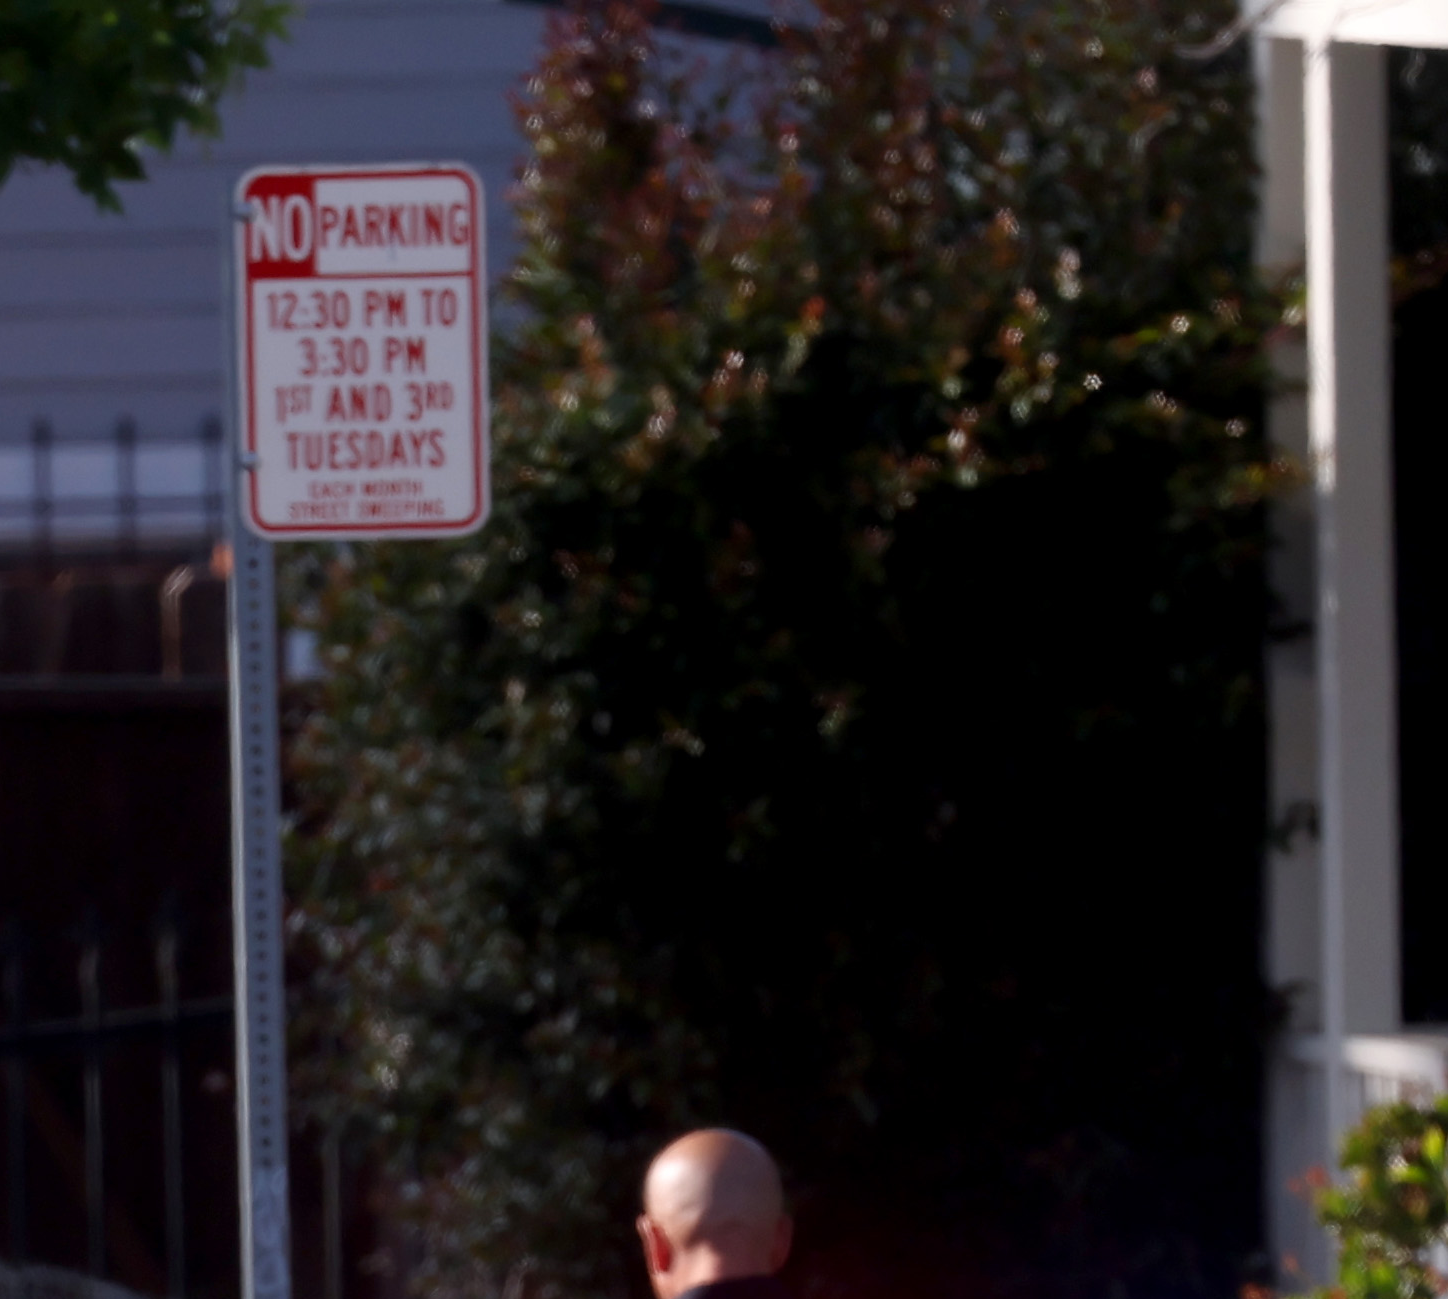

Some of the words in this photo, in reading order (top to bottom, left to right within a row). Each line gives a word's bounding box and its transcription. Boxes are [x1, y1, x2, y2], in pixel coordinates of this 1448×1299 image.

[249, 195, 313, 262] NO
[320, 204, 470, 248] PARKING
[267, 290, 352, 331] 12:30
[362, 290, 407, 328] PM
[420, 288, 458, 326] TO
[298, 338, 370, 377] 3:30
[383, 336, 427, 374] PM
[275, 384, 312, 425] 1ST
[326, 384, 392, 423] AND
[403, 382, 454, 421] 3RD
[285, 430, 447, 471] TUESDAYS
